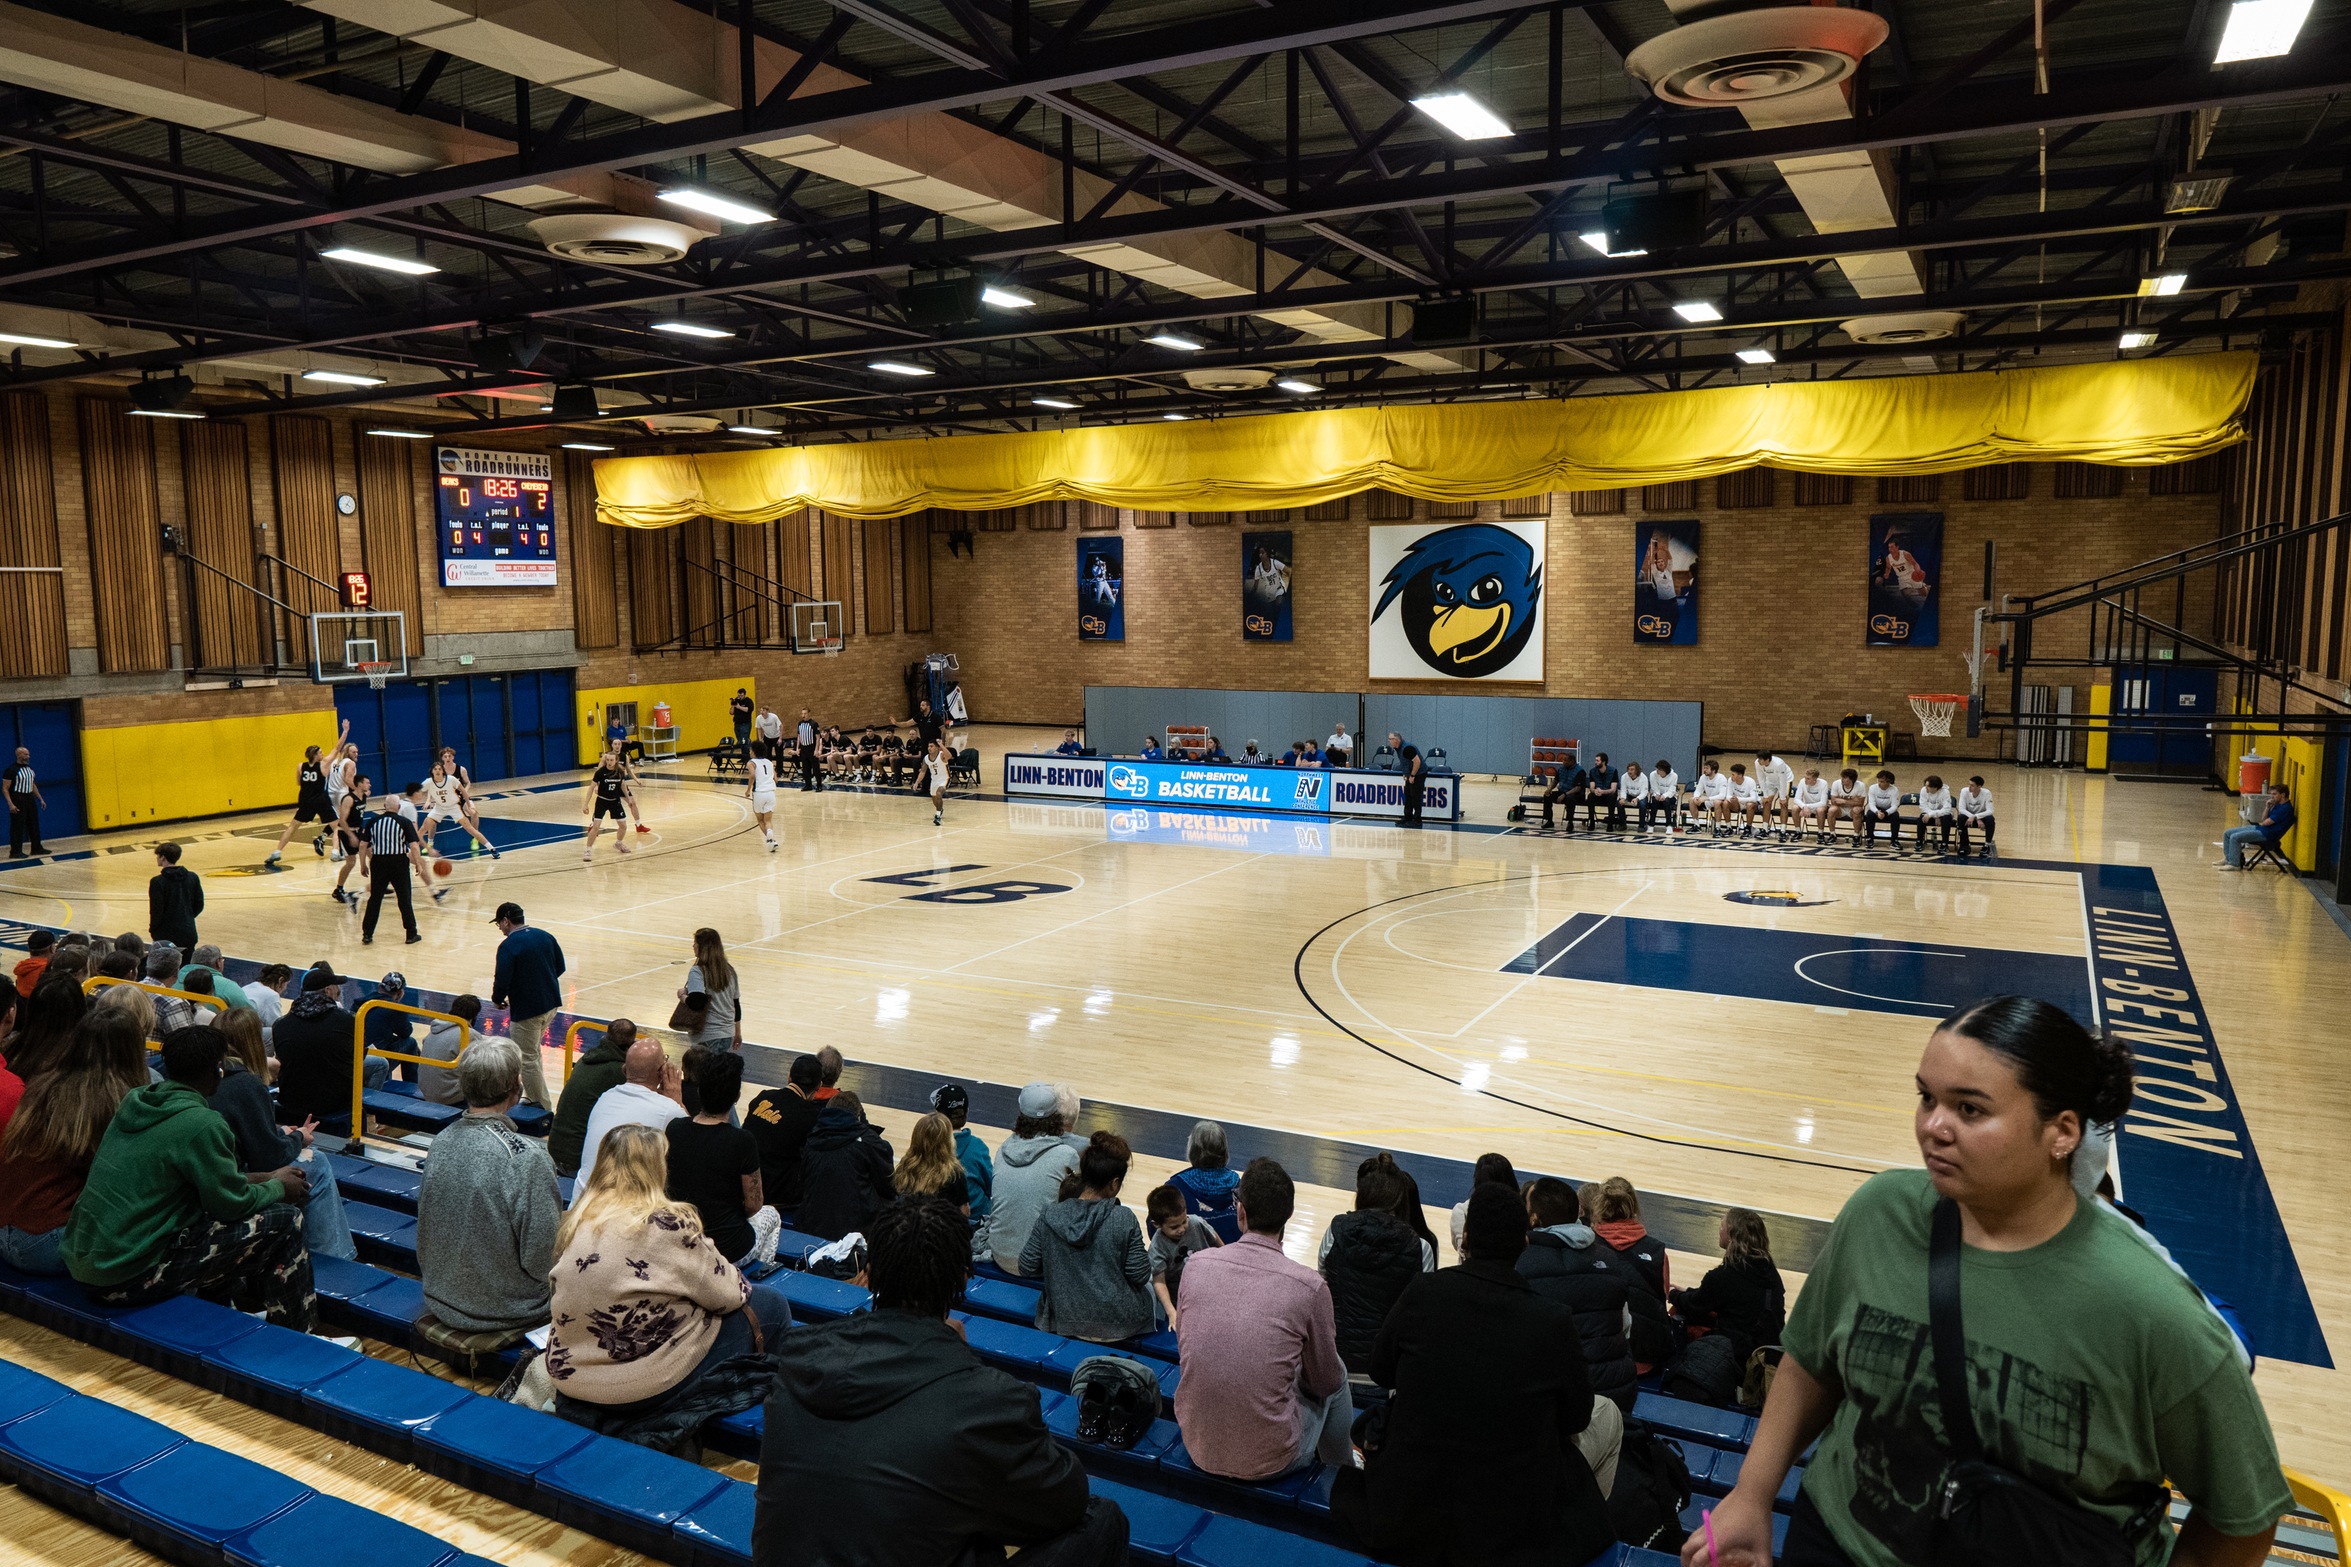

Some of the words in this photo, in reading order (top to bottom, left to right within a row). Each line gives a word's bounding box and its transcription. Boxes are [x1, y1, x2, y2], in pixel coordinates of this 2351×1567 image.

[465, 452, 498, 461] HOME
[507, 455, 519, 463] OF
[527, 456, 548, 464] THE
[465, 460, 549, 477] ROADRUNNERS
[484, 479, 518, 497] 18:26
[460, 488, 470, 506] 0
[537, 492, 547, 509] 2
[491, 508, 508, 516] period
[515, 506, 520, 518] 1
[491, 521, 509, 530] player
[454, 530, 462, 545] 0
[473, 531, 482, 544] 4
[520, 533, 528, 545] 4
[540, 533, 548, 546] 0
[351, 583, 368, 604] 12
[302, 770, 318, 782] 30
[1010, 764, 1104, 789] LINN-BENTON
[1180, 770, 1249, 783] LINN-BENTON
[608, 783, 617, 791] 13
[1158, 782, 1272, 803] BASKETBALL
[440, 796, 447, 804] 5
[2092, 905, 2244, 1160] LINN-BENTON
